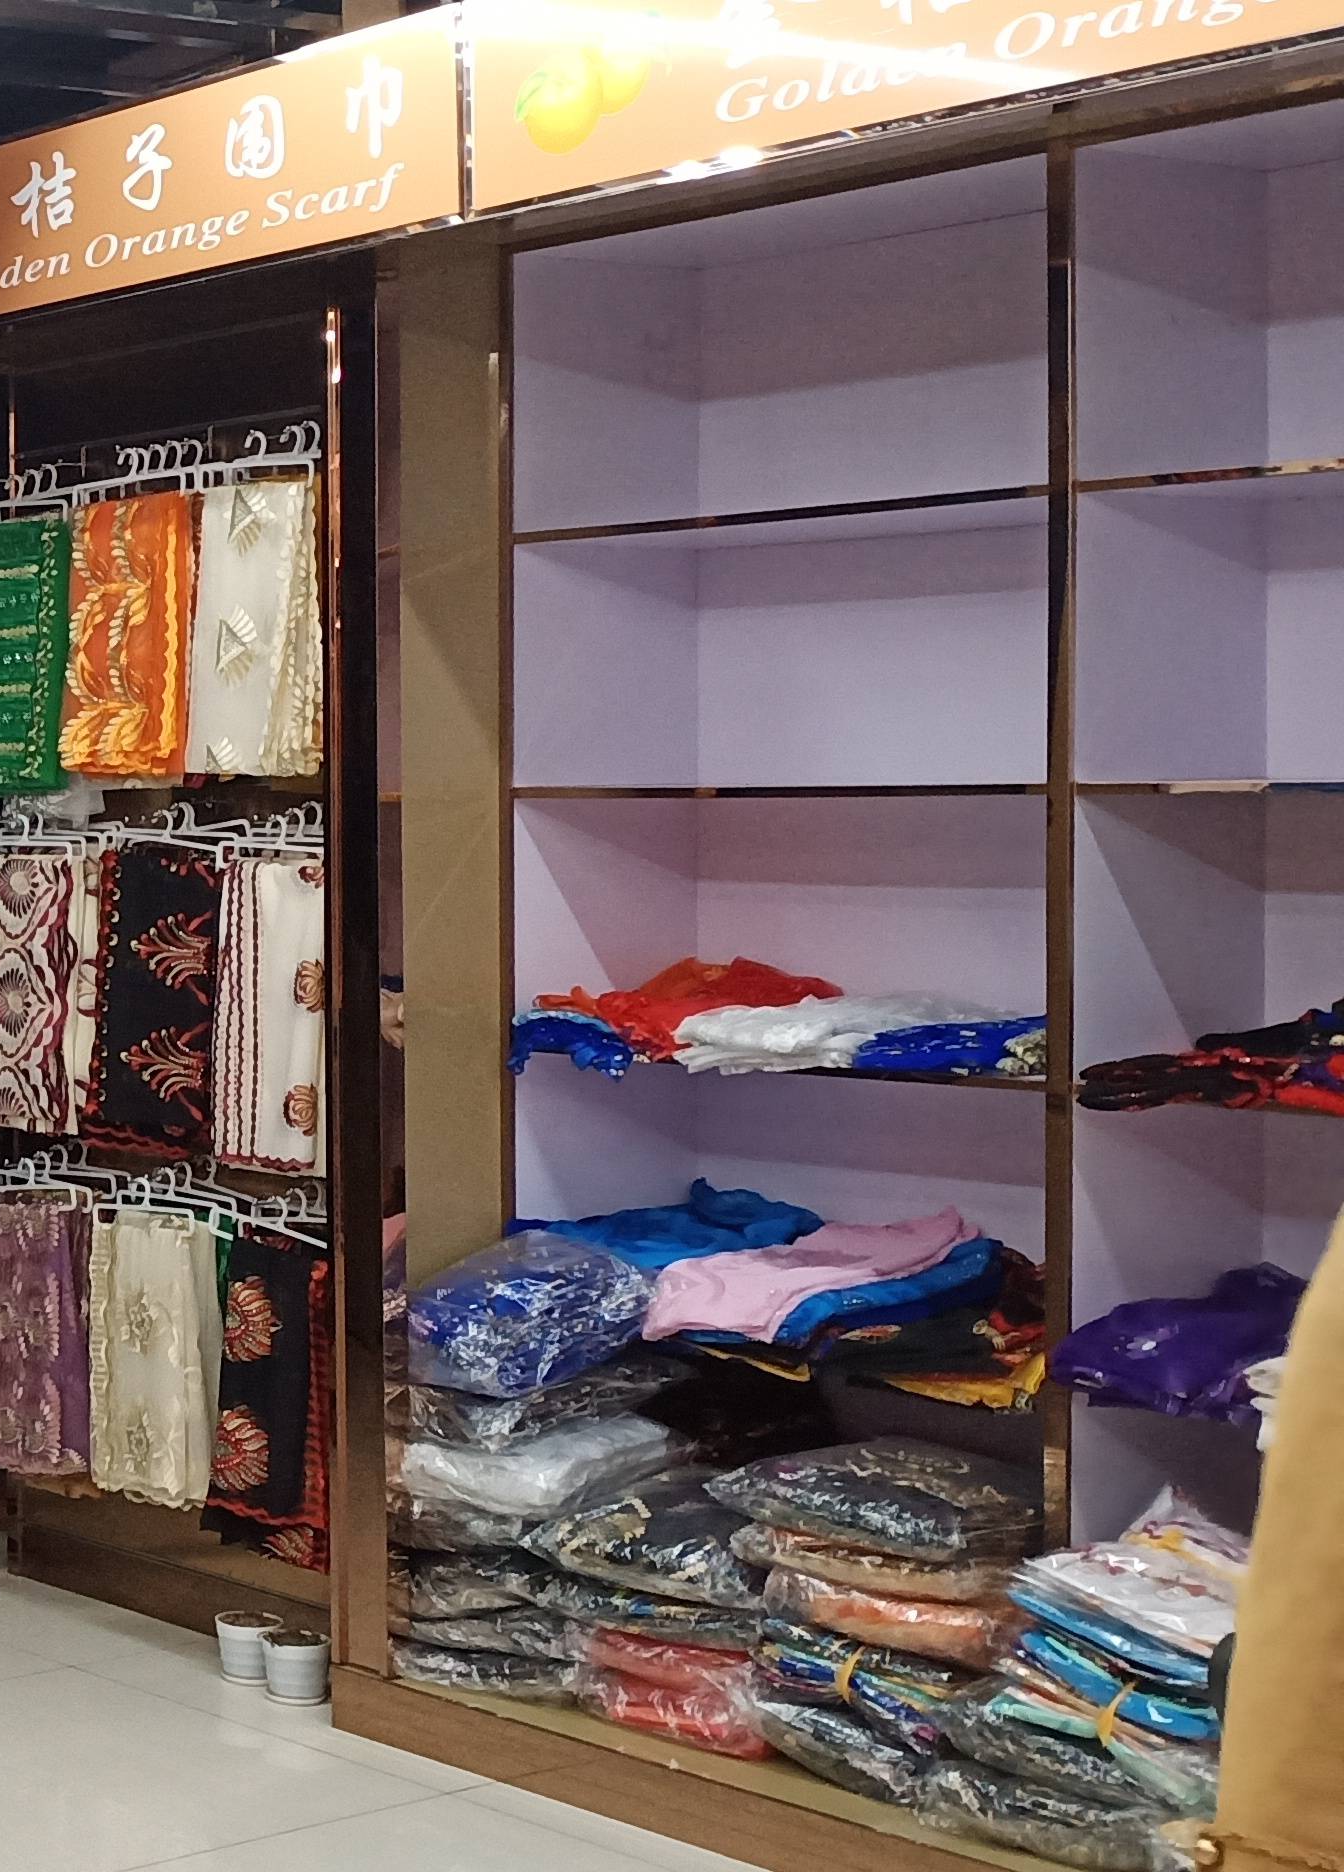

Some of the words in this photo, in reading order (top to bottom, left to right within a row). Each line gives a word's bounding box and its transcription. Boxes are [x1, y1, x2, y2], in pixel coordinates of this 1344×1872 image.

[715, 43, 968, 123] Gold
[83, 207, 250, 269] Orange
[260, 163, 405, 230] Scarf
